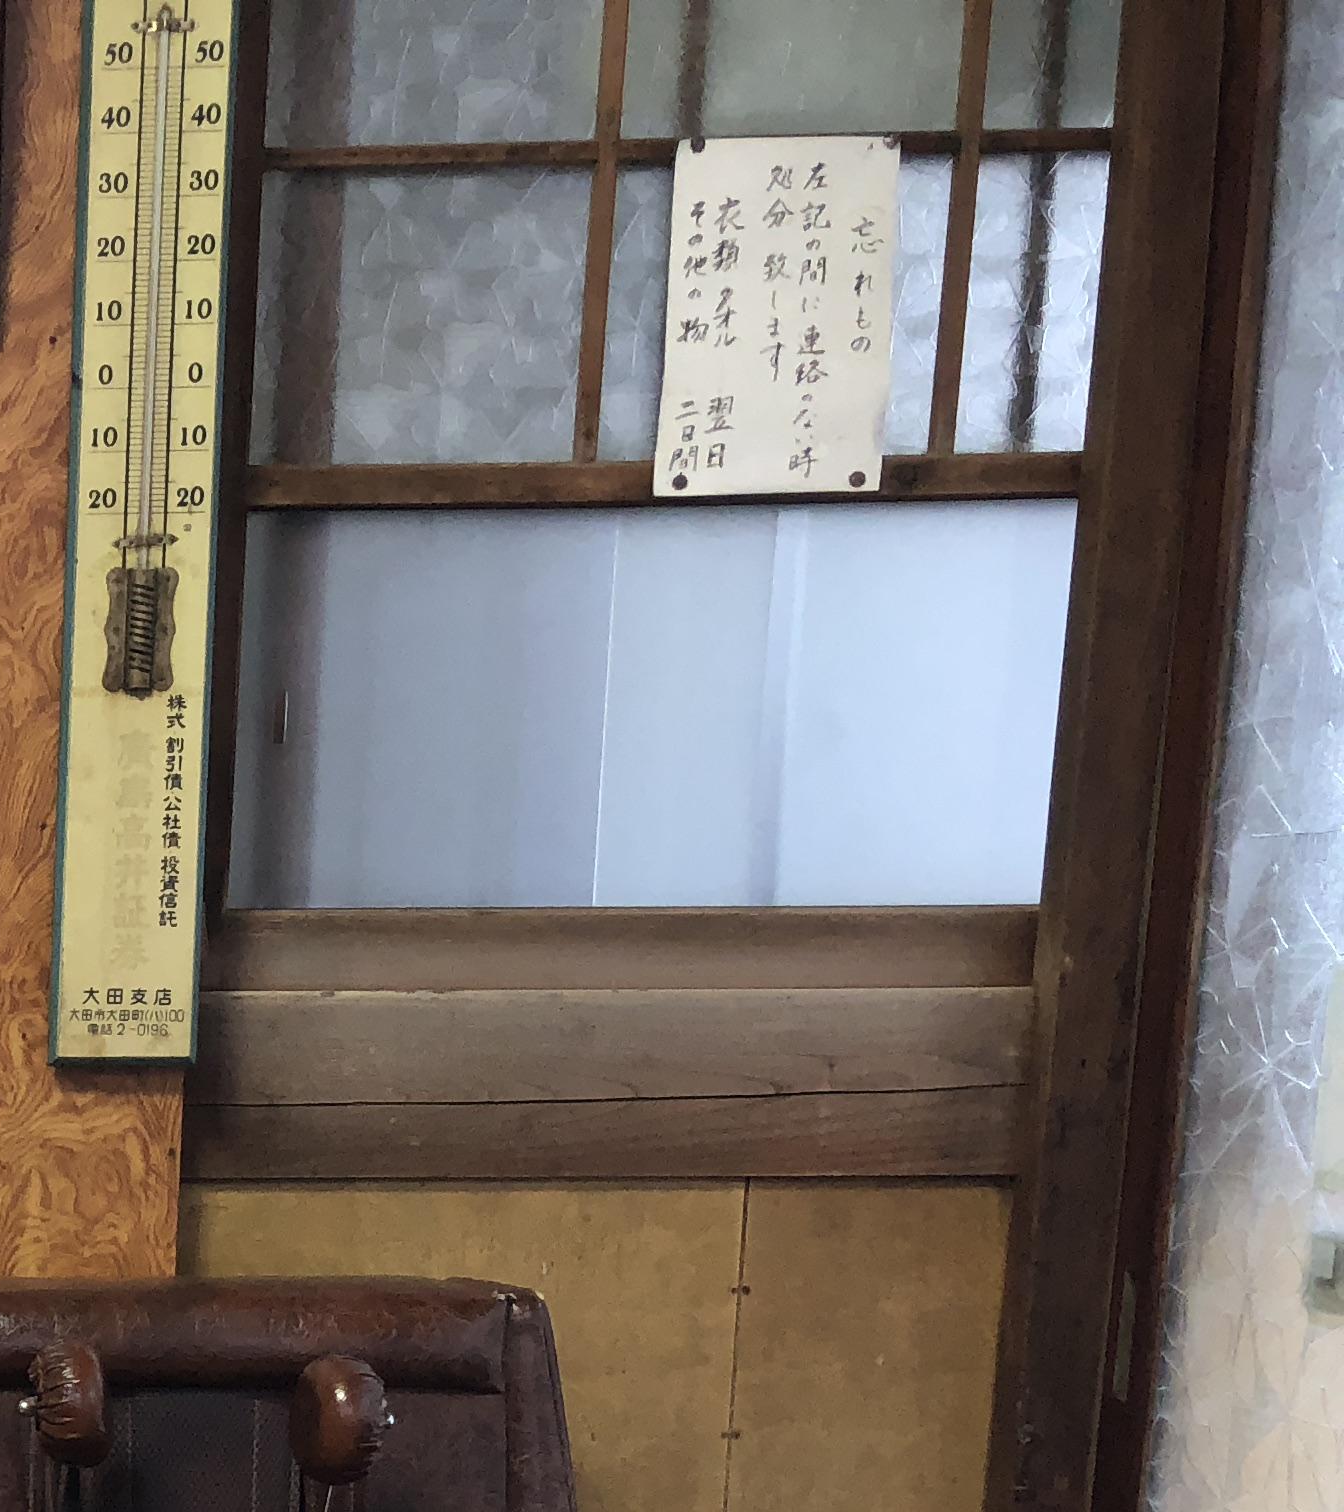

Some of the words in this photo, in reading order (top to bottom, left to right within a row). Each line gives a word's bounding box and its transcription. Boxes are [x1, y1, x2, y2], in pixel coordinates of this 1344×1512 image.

[104, 42, 134, 65] 50
[195, 40, 225, 64] 50
[101, 105, 131, 130] 40
[191, 103, 222, 128] 40
[98, 171, 128, 195] 30
[189, 169, 219, 192] 30
[96, 236, 126, 258] 20
[187, 233, 216, 256] 20
[850, 215, 885, 353] 忘れもの
[95, 299, 122, 322] 10
[185, 297, 213, 320] 10
[97, 364, 114, 386] 0
[187, 362, 204, 384] 0
[91, 426, 119, 449] 10
[180, 424, 208, 447] 10
[88, 487, 117, 510] 20
[176, 485, 205, 508] 20
[166, 693, 187, 730] 株式
[163, 736, 185, 791] 割引債
[161, 793, 183, 850] 公社債
[158, 856, 181, 928] 投資信託
[82, 986, 173, 1006] 大田支店
